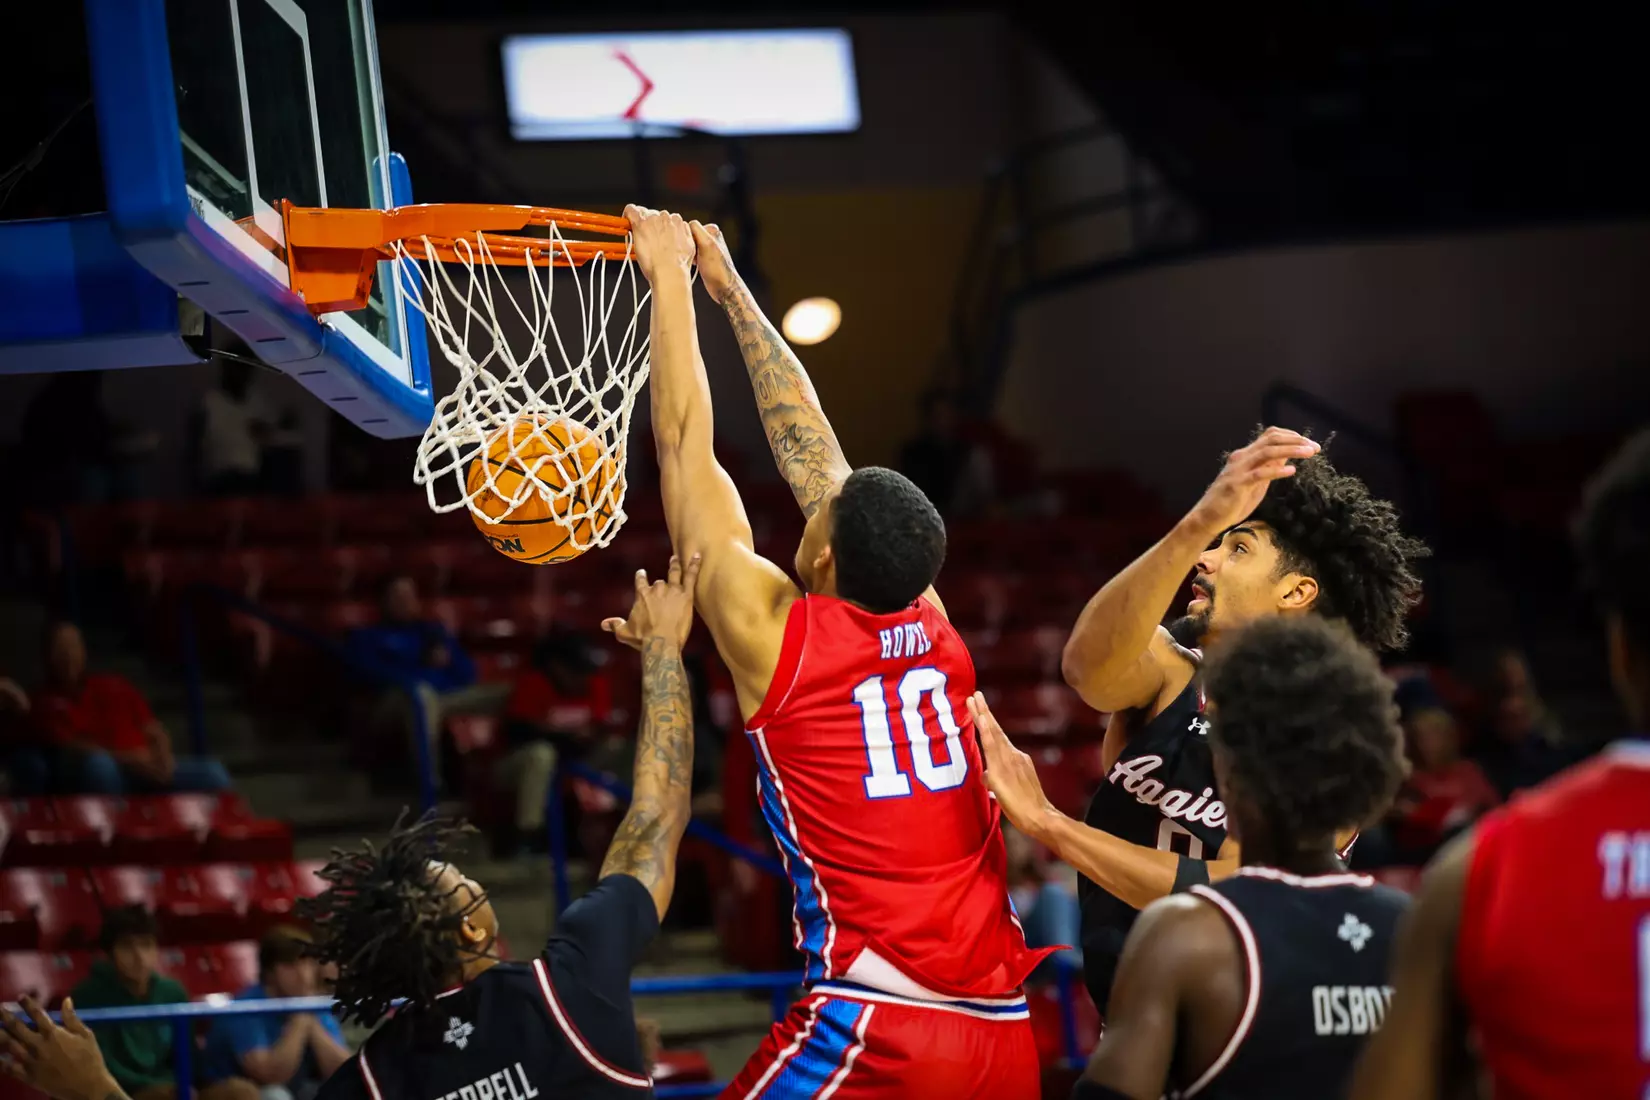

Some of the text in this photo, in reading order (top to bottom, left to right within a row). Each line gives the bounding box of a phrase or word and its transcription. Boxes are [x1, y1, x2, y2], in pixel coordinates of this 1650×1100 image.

[852, 665, 969, 800] 10
[1108, 754, 1229, 830] Aggie
[434, 1062, 539, 1100] RELL
